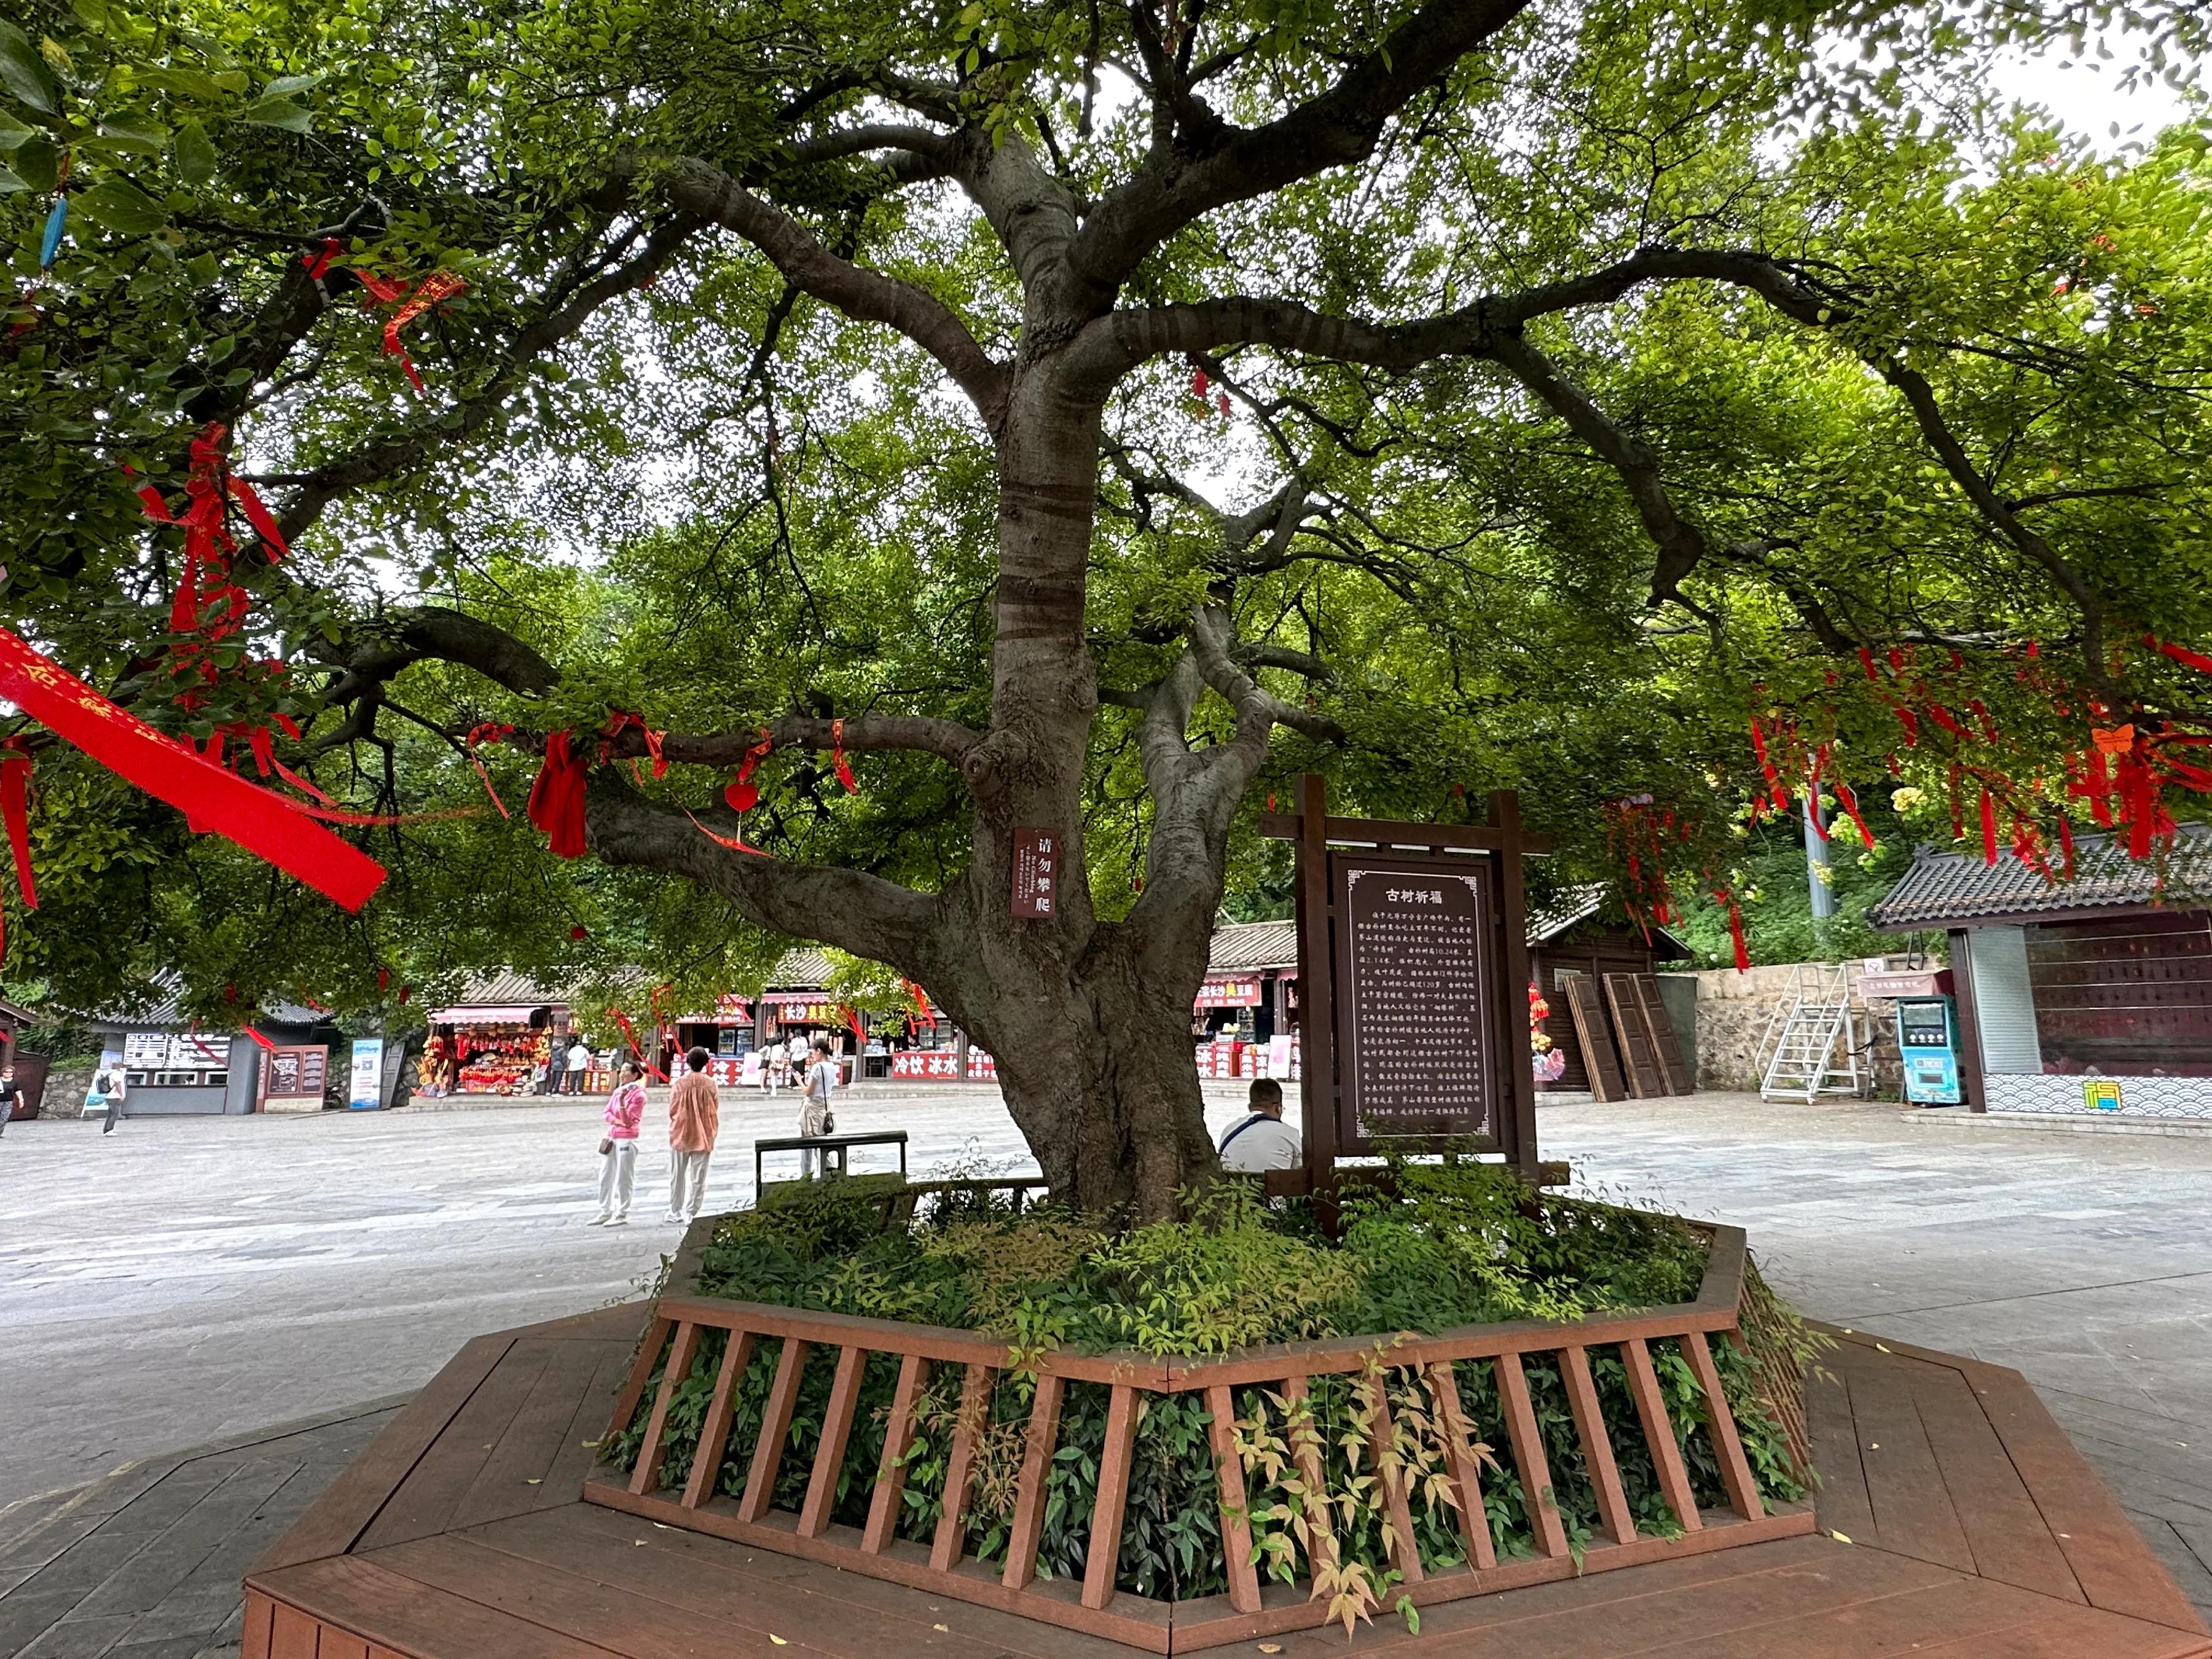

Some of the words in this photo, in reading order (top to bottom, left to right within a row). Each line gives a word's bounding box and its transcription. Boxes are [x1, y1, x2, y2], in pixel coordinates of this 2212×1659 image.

[1035, 837, 1053, 912] 请勿攀爬
[1386, 888, 1442, 904] 古树祈福
[894, 1056, 924, 1075] 冷饮
[927, 1056, 958, 1075] 冰水
